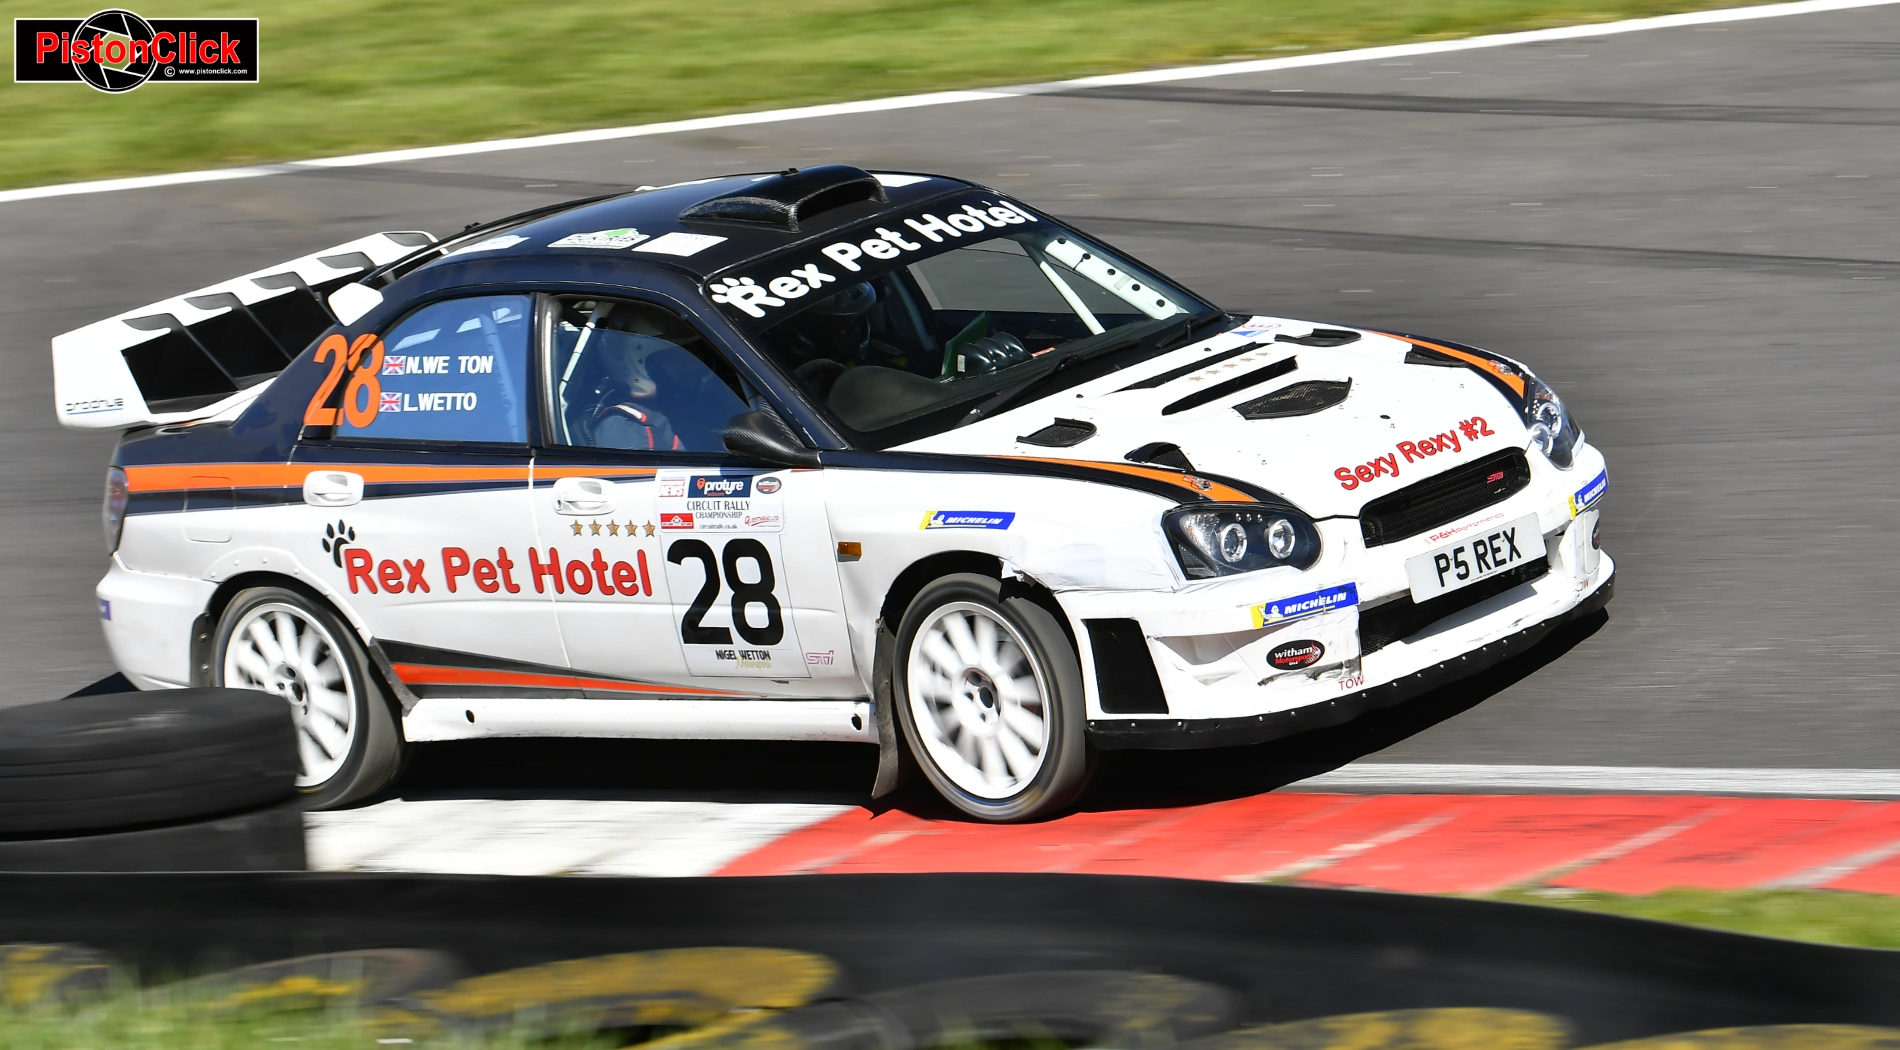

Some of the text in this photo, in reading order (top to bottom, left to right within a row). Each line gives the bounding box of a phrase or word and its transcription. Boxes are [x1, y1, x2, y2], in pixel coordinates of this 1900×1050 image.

[724, 200, 1038, 318] Rex Pet Hotel
[303, 333, 385, 429] 28
[403, 392, 478, 412] L.WETTO
[1334, 416, 1495, 490] Sexy Rexy #2
[704, 479, 744, 495] protyre
[1583, 478, 1607, 503] MICHELIN
[686, 501, 751, 511] CIRCUIT RALLY
[945, 516, 1004, 525] MICHELIN
[1434, 526, 1522, 588] P5 REX
[344, 546, 653, 597] Rex Pet Hotel
[667, 538, 784, 646] 28
[1284, 591, 1348, 615] MICHELIN
[715, 650, 772, 660] NIGEL WETTON
[1274, 646, 1313, 659] witham
[1338, 676, 1364, 691] TOW
